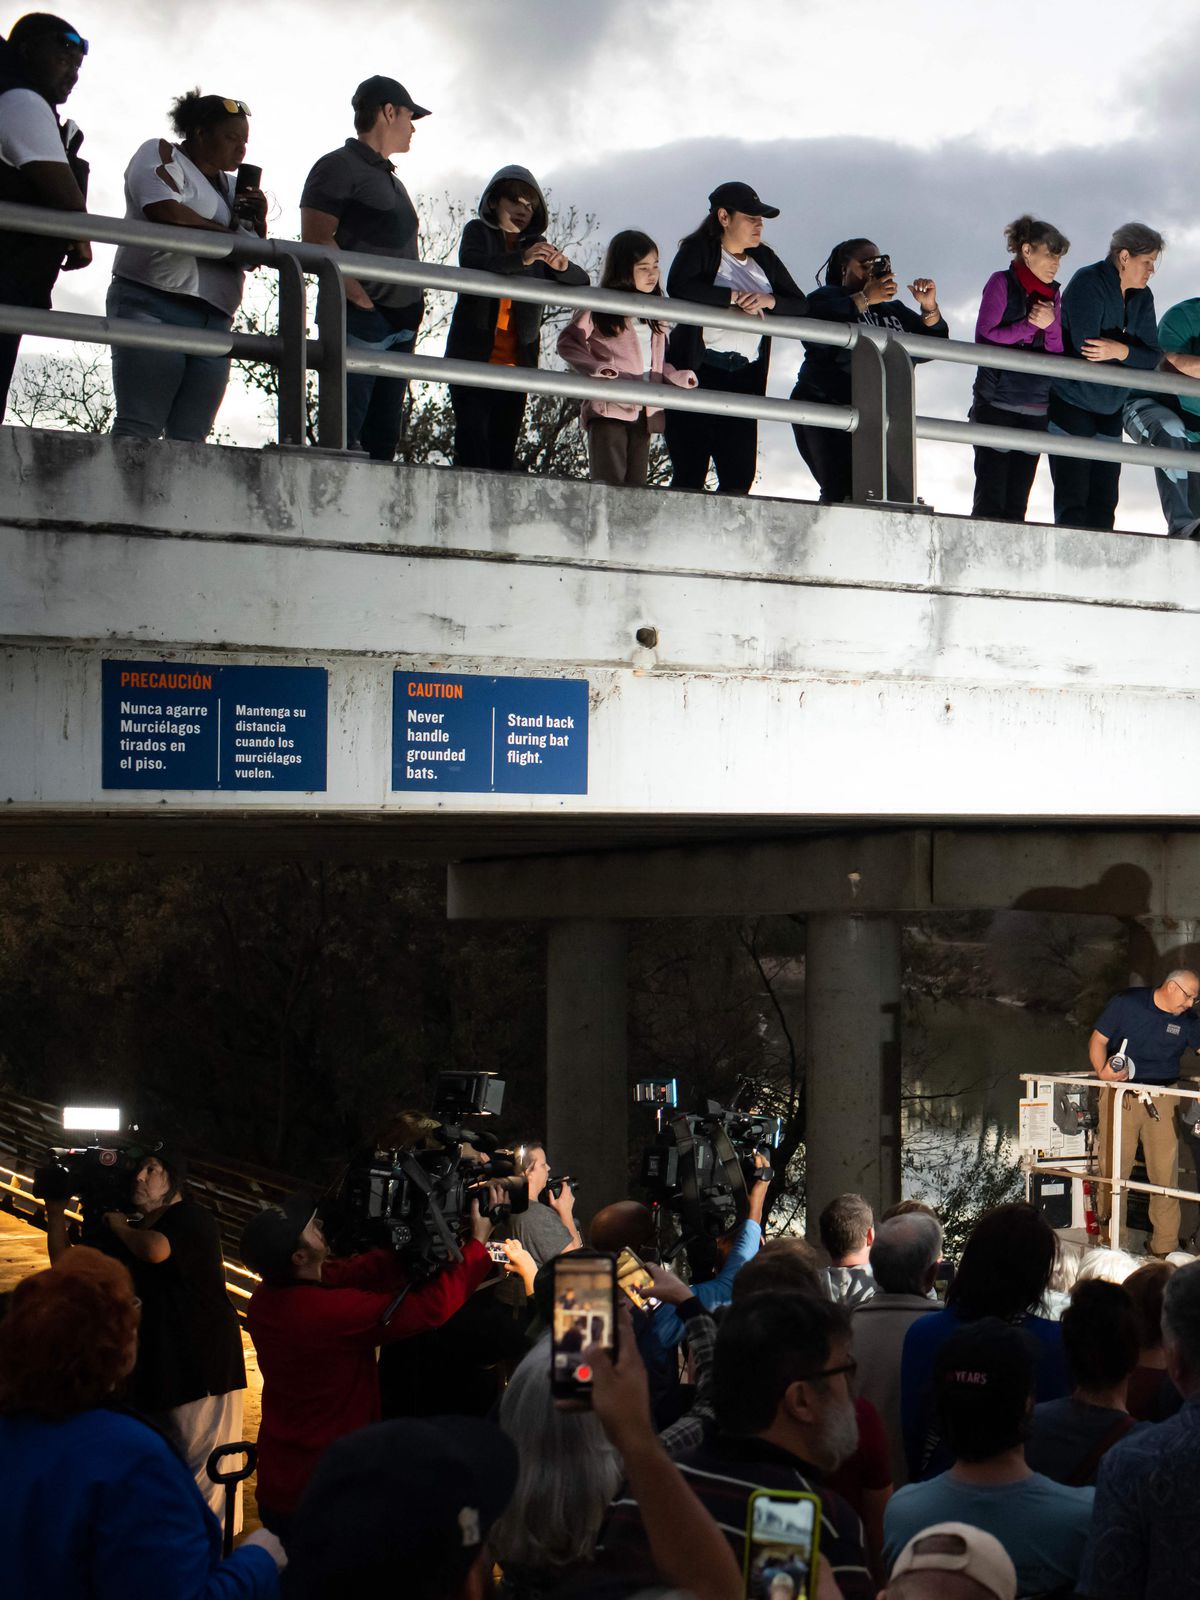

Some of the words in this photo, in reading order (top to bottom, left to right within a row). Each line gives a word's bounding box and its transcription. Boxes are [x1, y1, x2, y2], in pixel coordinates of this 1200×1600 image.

[121, 672, 212, 690] PRECAUCIÓN
[408, 682, 463, 699] CAUTION
[121, 702, 162, 715] Nunca
[166, 705, 208, 718] agarre
[235, 705, 290, 718] Mantenga
[293, 708, 306, 718] su
[408, 710, 444, 723] Never
[120, 720, 201, 736] Murciélagos
[235, 721, 286, 733] distancia
[507, 714, 543, 728] Stand
[546, 716, 574, 729] back
[407, 729, 449, 742] handle
[507, 733, 546, 748] during
[549, 734, 569, 747] bat
[120, 739, 167, 751] tirados
[170, 742, 186, 752] en
[235, 738, 275, 748] cuando
[278, 738, 294, 748] los
[235, 752, 302, 765] murciélagos
[407, 749, 466, 762] grounded
[507, 751, 543, 765] flight.
[120, 757, 132, 769] el
[136, 758, 167, 772] piso.
[235, 768, 275, 779] vuelen.
[407, 766, 438, 780] bats.
[955, 1370, 988, 1385] YEARS
